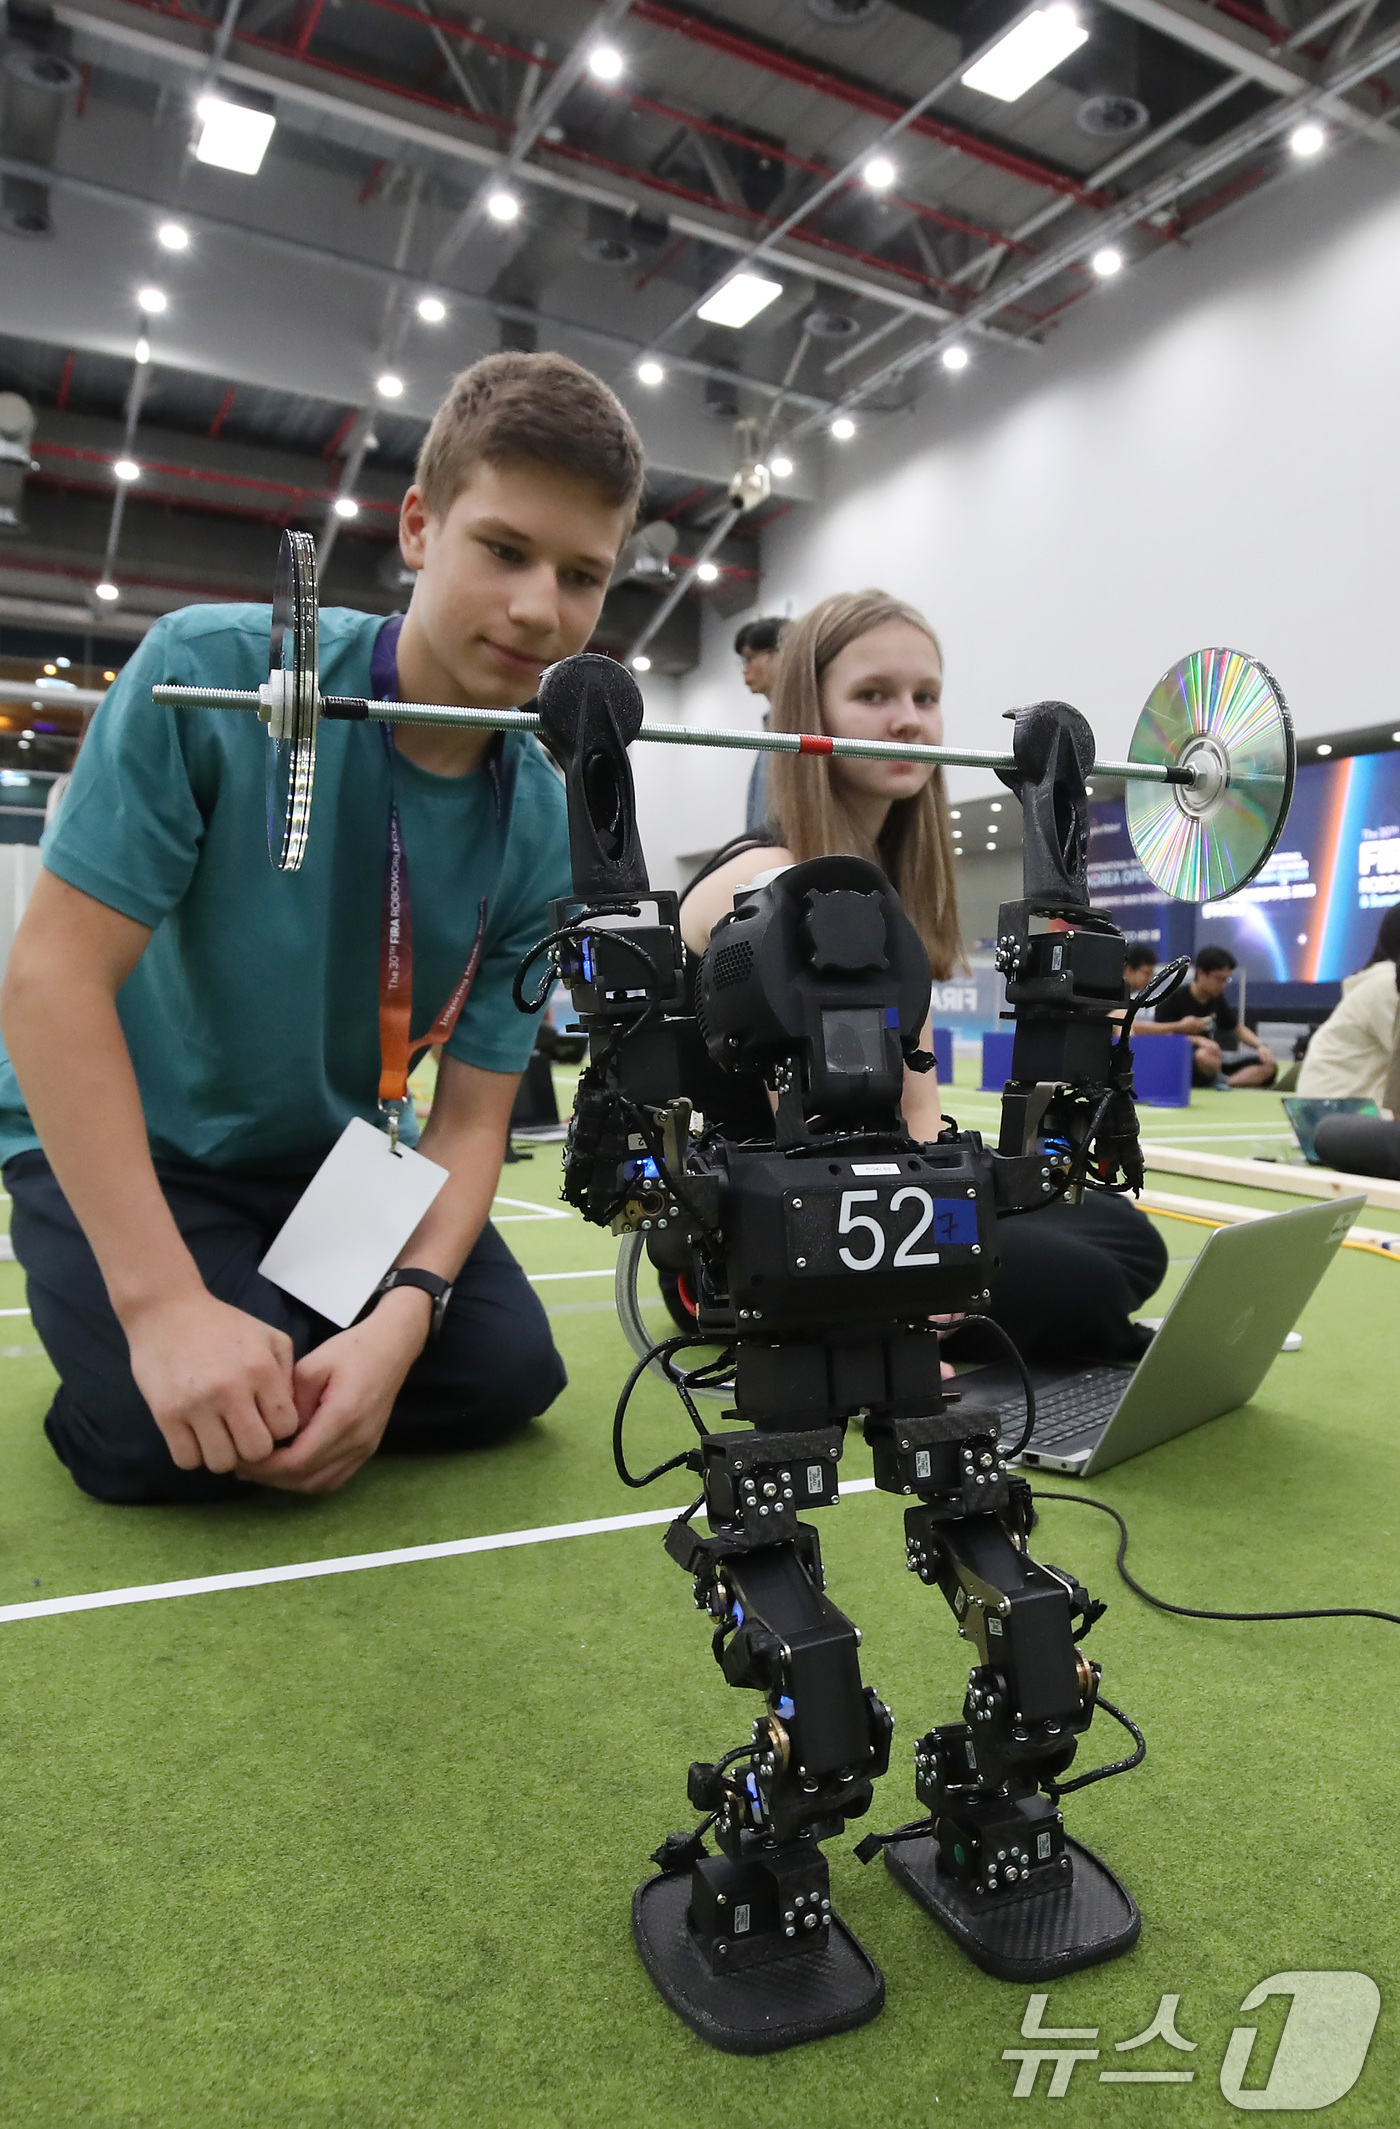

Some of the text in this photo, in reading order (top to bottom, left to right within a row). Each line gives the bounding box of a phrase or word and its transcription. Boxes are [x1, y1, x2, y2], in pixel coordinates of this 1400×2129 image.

[390, 843, 401, 917] ROBOWORLD
[389, 918, 400, 945] FIRA
[387, 971, 399, 989] The
[838, 1186, 940, 1271] 52
